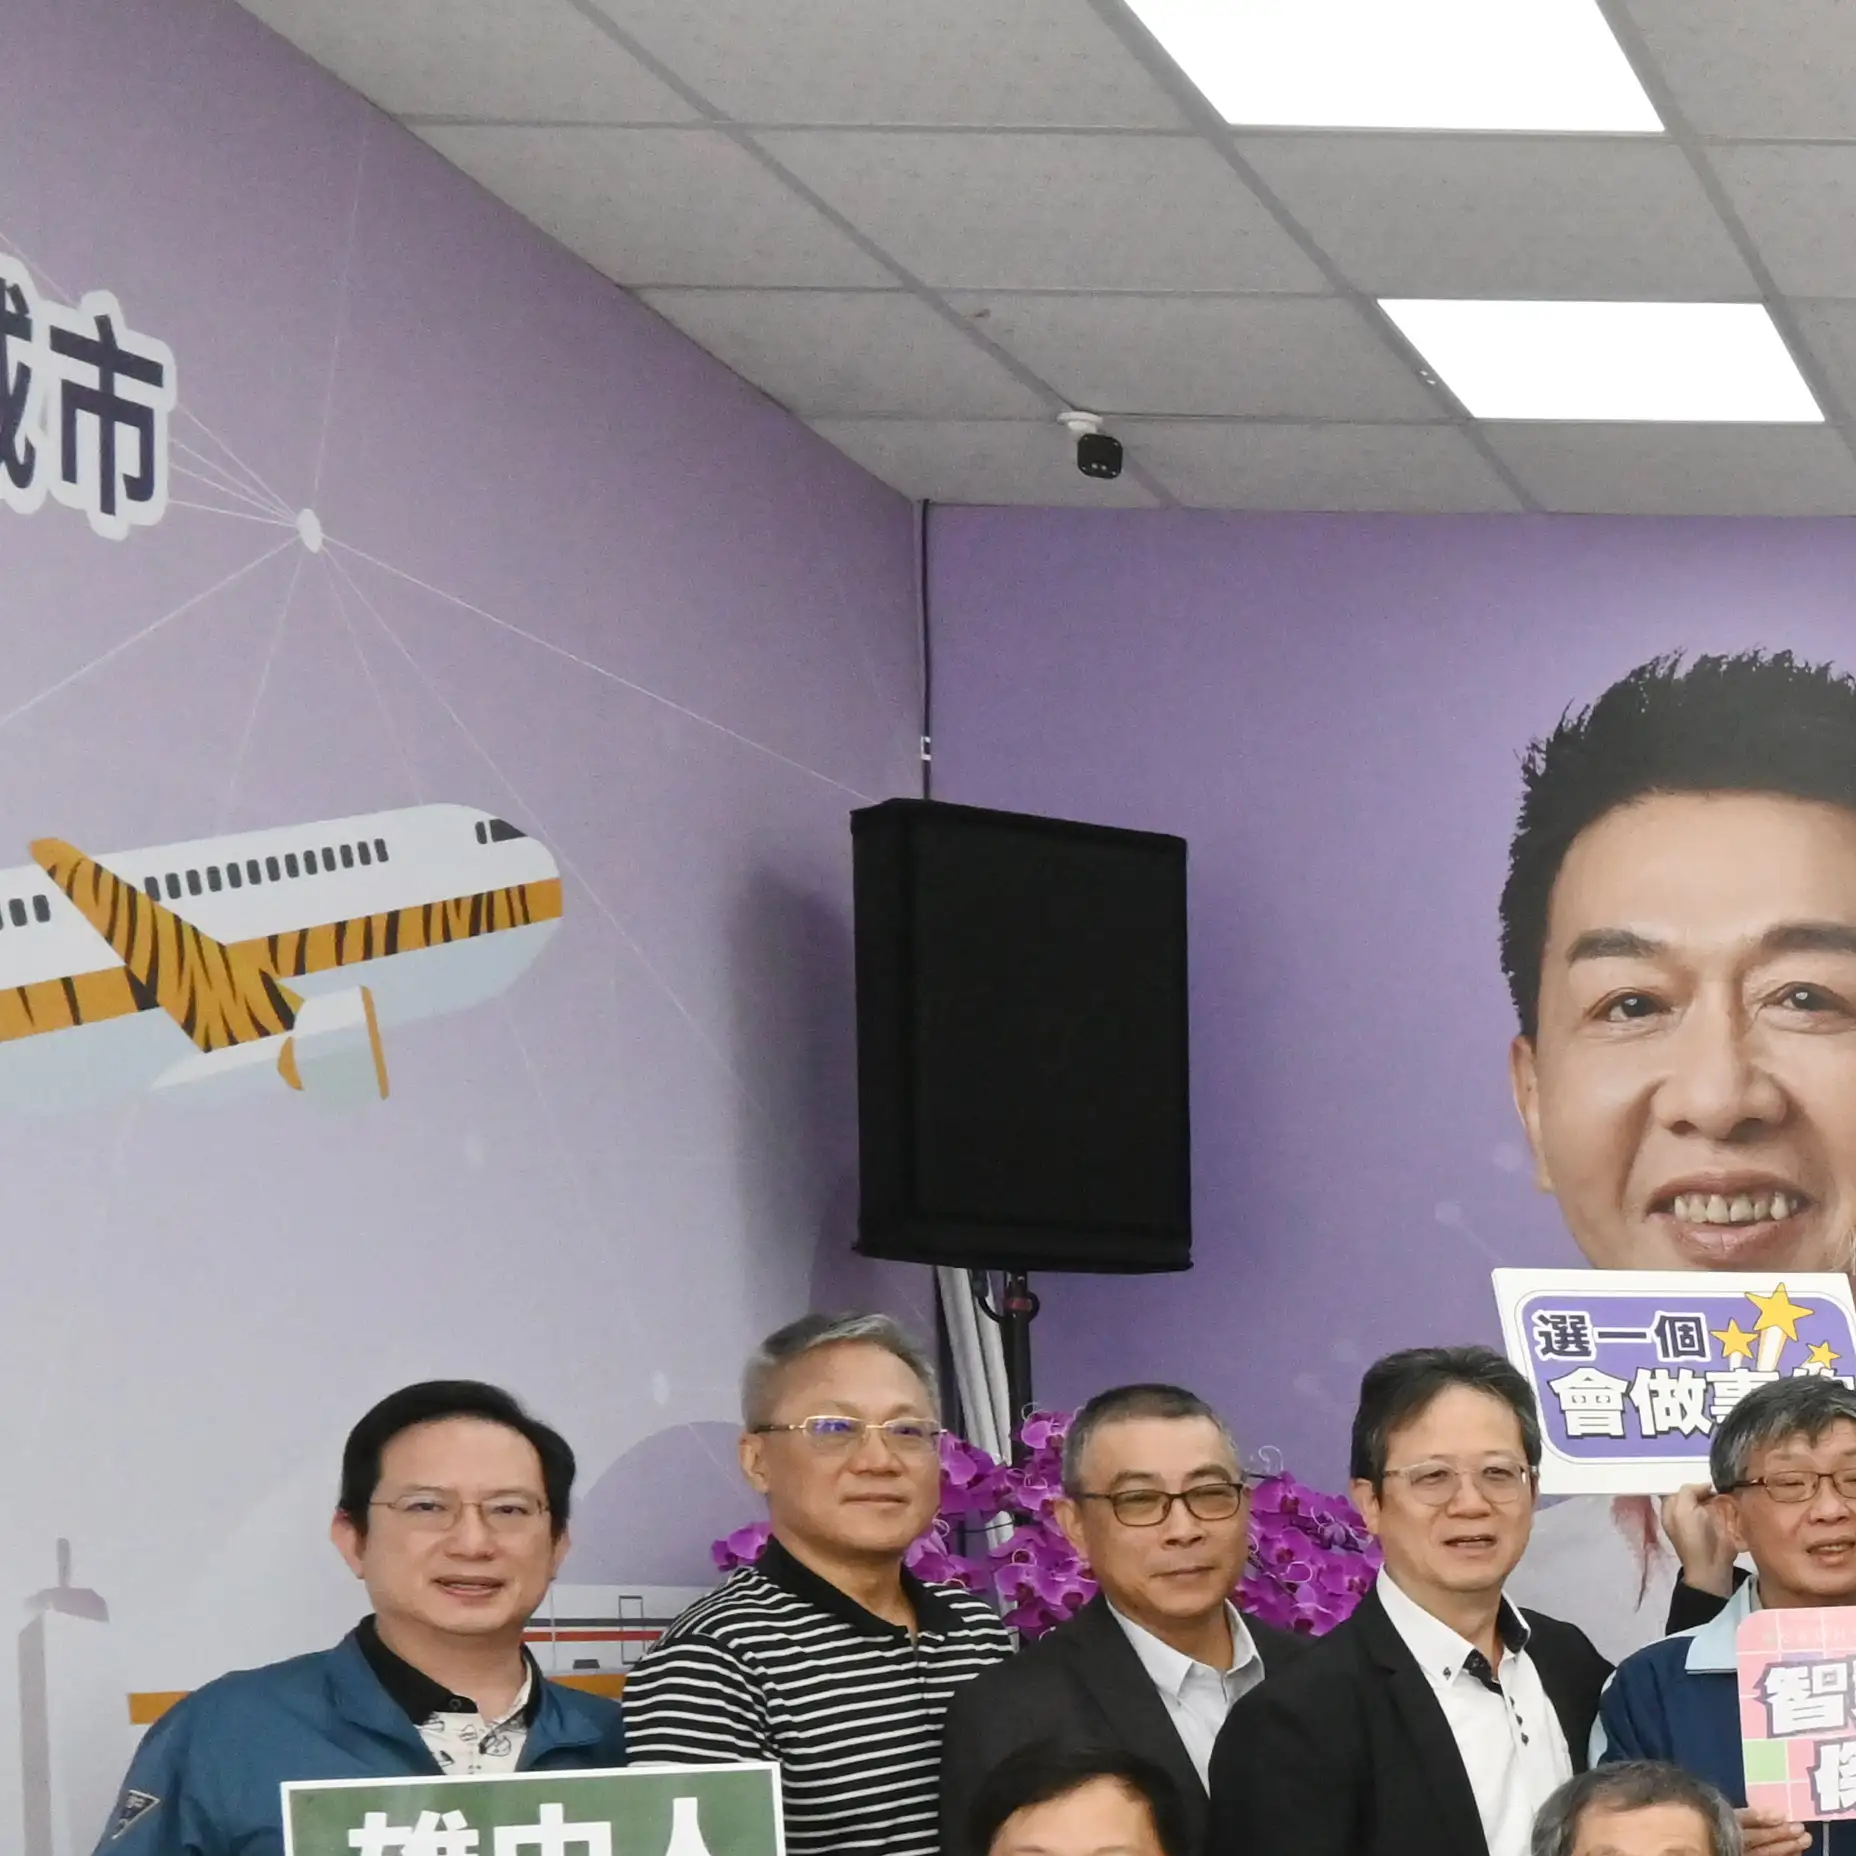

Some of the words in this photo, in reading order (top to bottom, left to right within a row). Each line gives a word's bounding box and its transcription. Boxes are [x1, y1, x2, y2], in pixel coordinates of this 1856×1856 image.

[1534, 1312, 1707, 1360] 選一個
[1548, 1366, 1855, 1439] 會做
